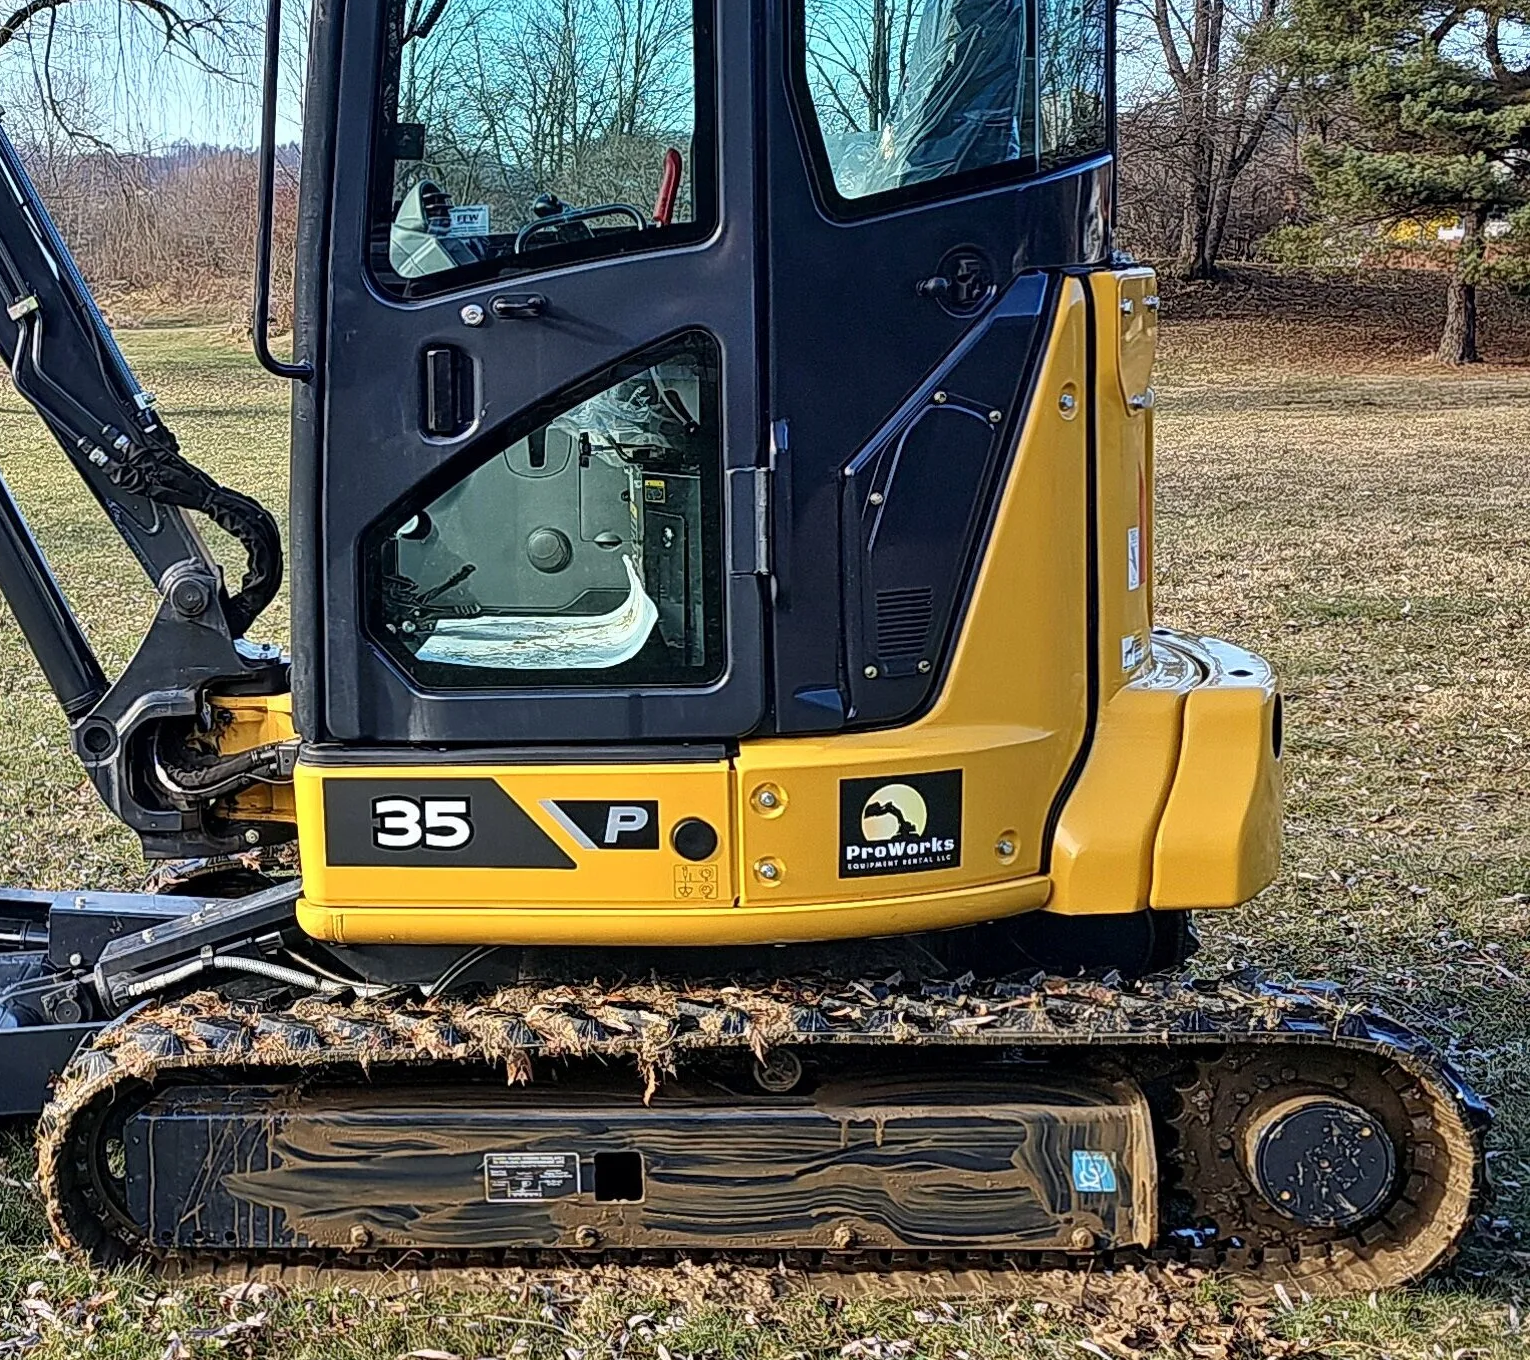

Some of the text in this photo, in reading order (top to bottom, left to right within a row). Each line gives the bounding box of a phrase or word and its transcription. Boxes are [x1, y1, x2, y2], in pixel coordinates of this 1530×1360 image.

[374, 798, 471, 849] 35
[604, 806, 650, 844] P
[846, 837, 955, 860] ProWorks
[847, 854, 952, 870] EQUIPMENT RENTAL LLC
